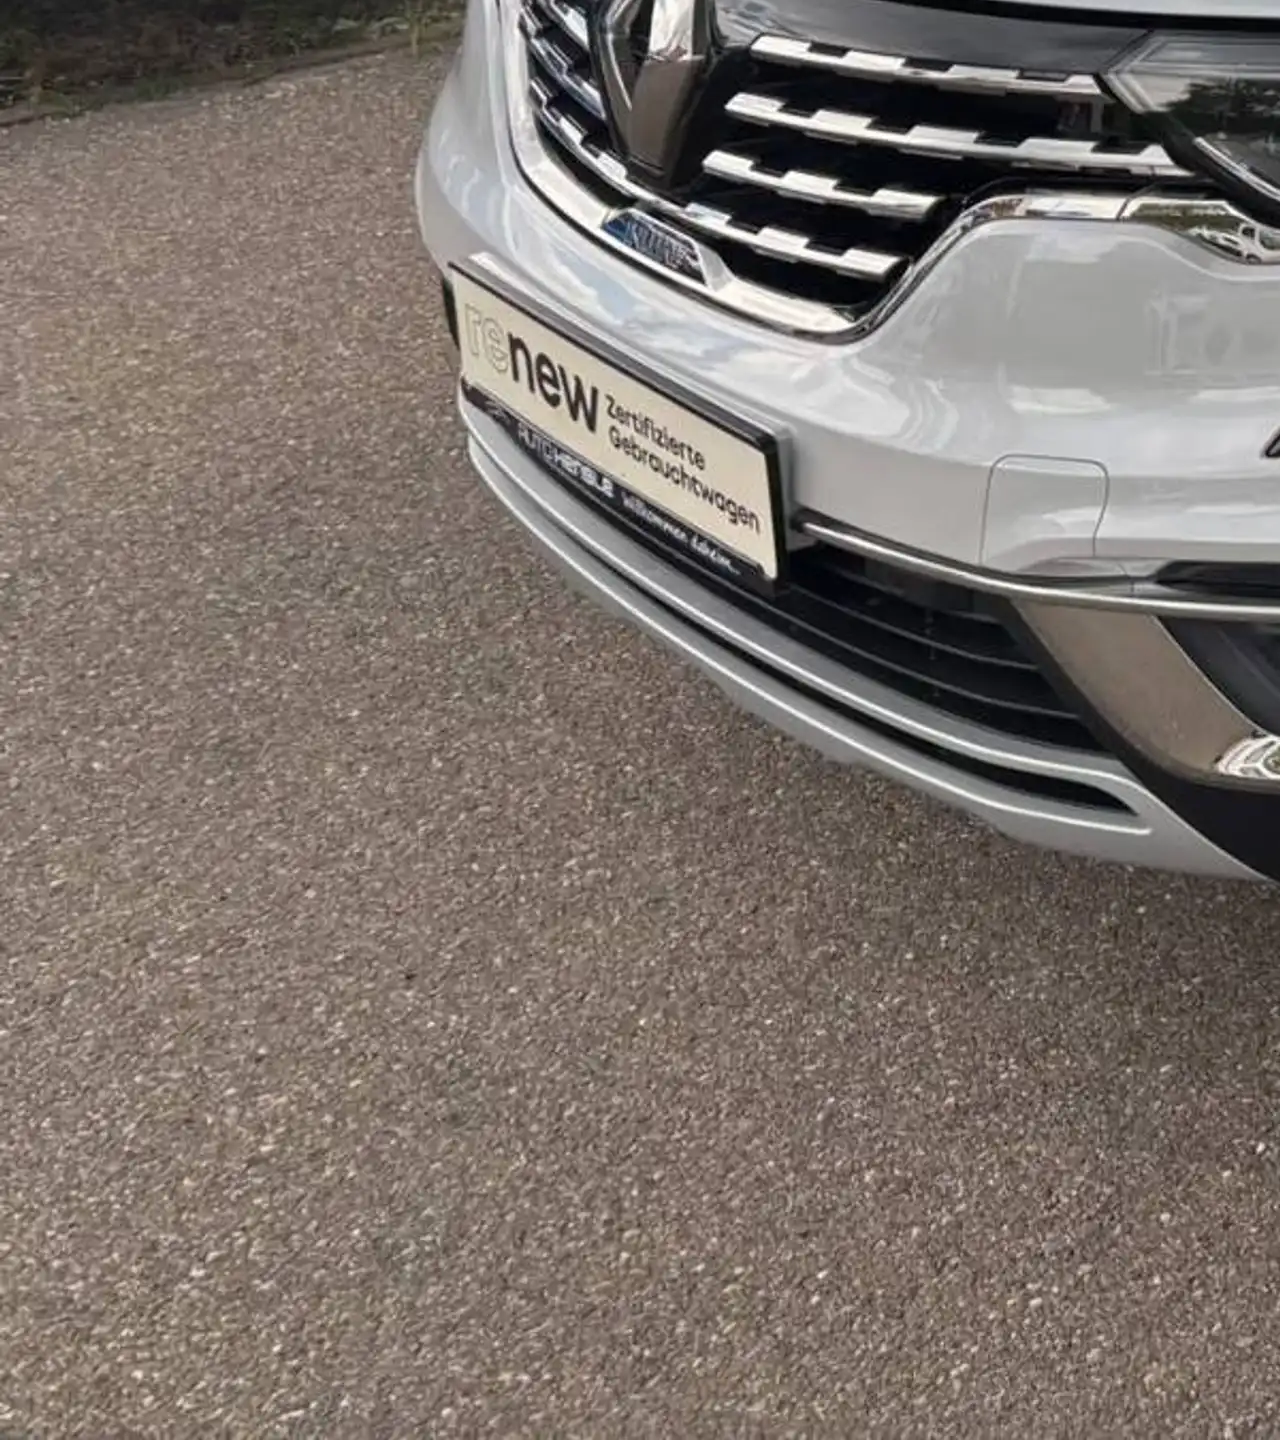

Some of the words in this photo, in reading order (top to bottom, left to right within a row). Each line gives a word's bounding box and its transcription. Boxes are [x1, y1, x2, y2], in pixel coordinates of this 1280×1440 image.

[465, 304, 600, 434] renew
[605, 394, 706, 471] Zertifizierte
[608, 426, 761, 535] Gebrauchtwagen
